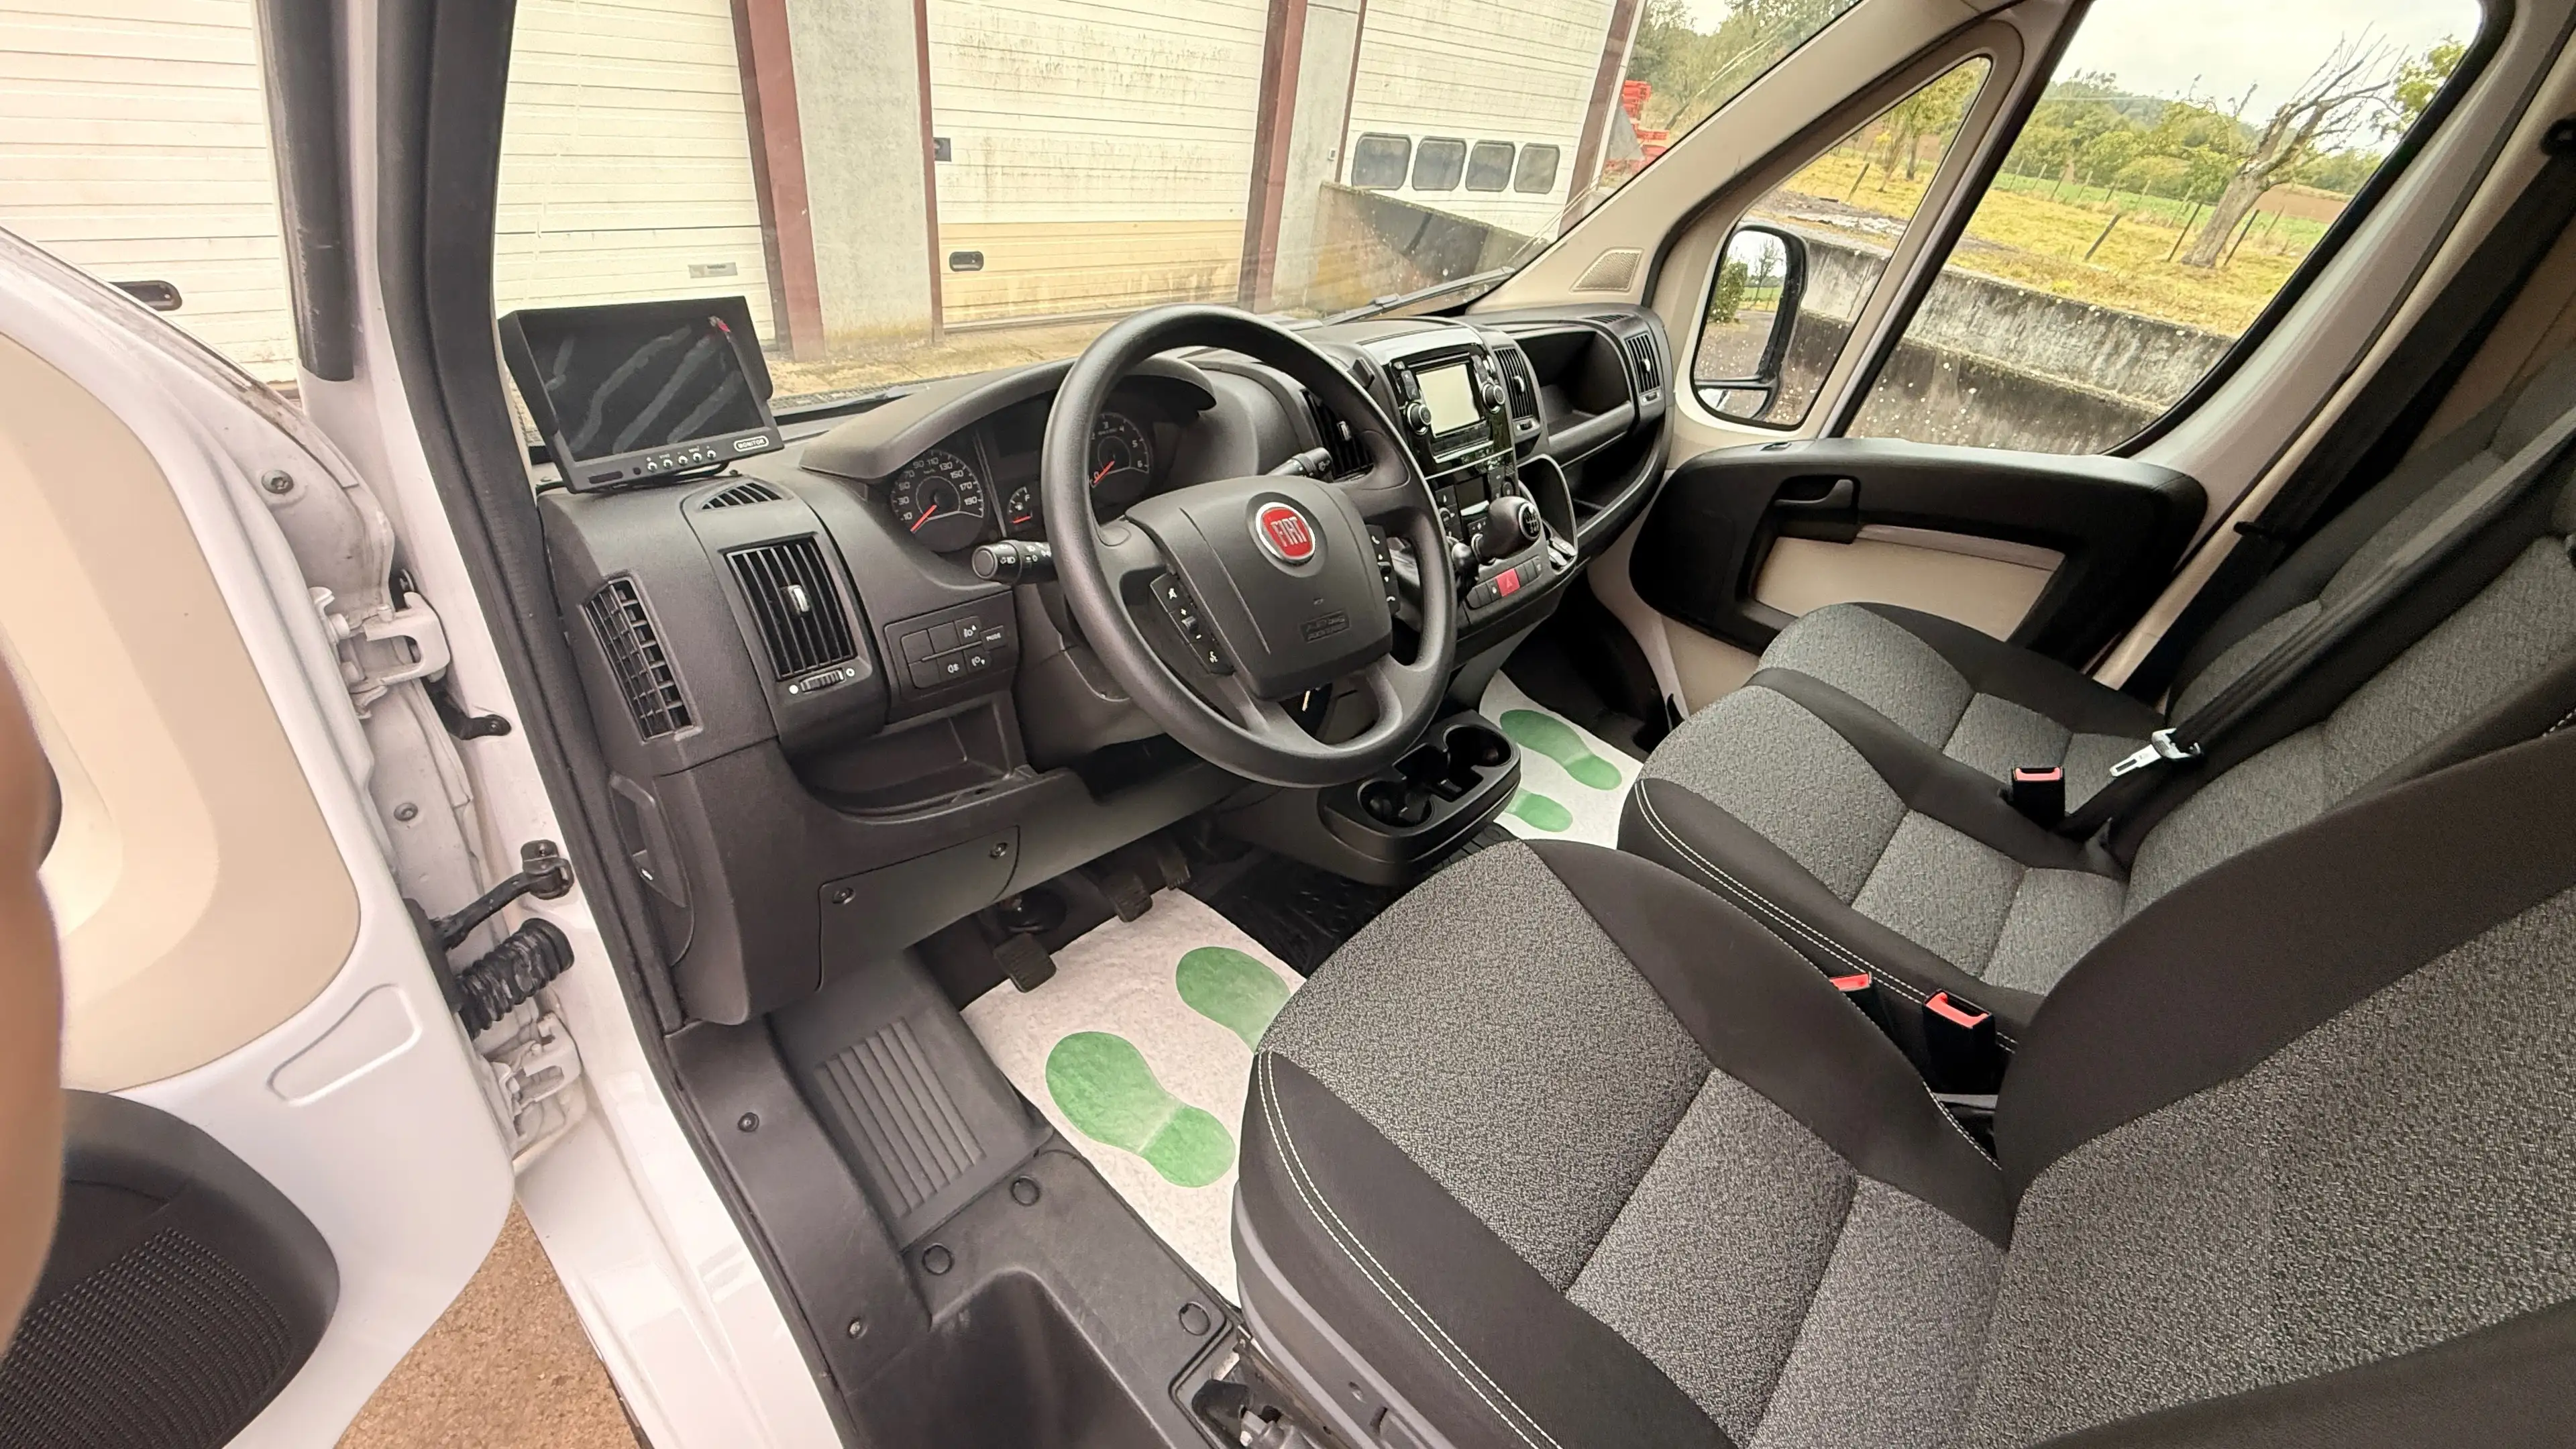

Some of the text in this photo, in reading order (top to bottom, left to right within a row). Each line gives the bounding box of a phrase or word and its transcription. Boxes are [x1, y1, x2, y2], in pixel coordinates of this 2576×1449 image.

[738, 439, 765, 448] MONITOR
[913, 460, 924, 468] 90
[939, 462, 953, 470] 130
[950, 470, 964, 478] 150
[959, 482, 973, 491] 170
[1025, 494, 1030, 502] F
[903, 512, 912, 520] 10
[1271, 516, 1307, 547] FIAT
